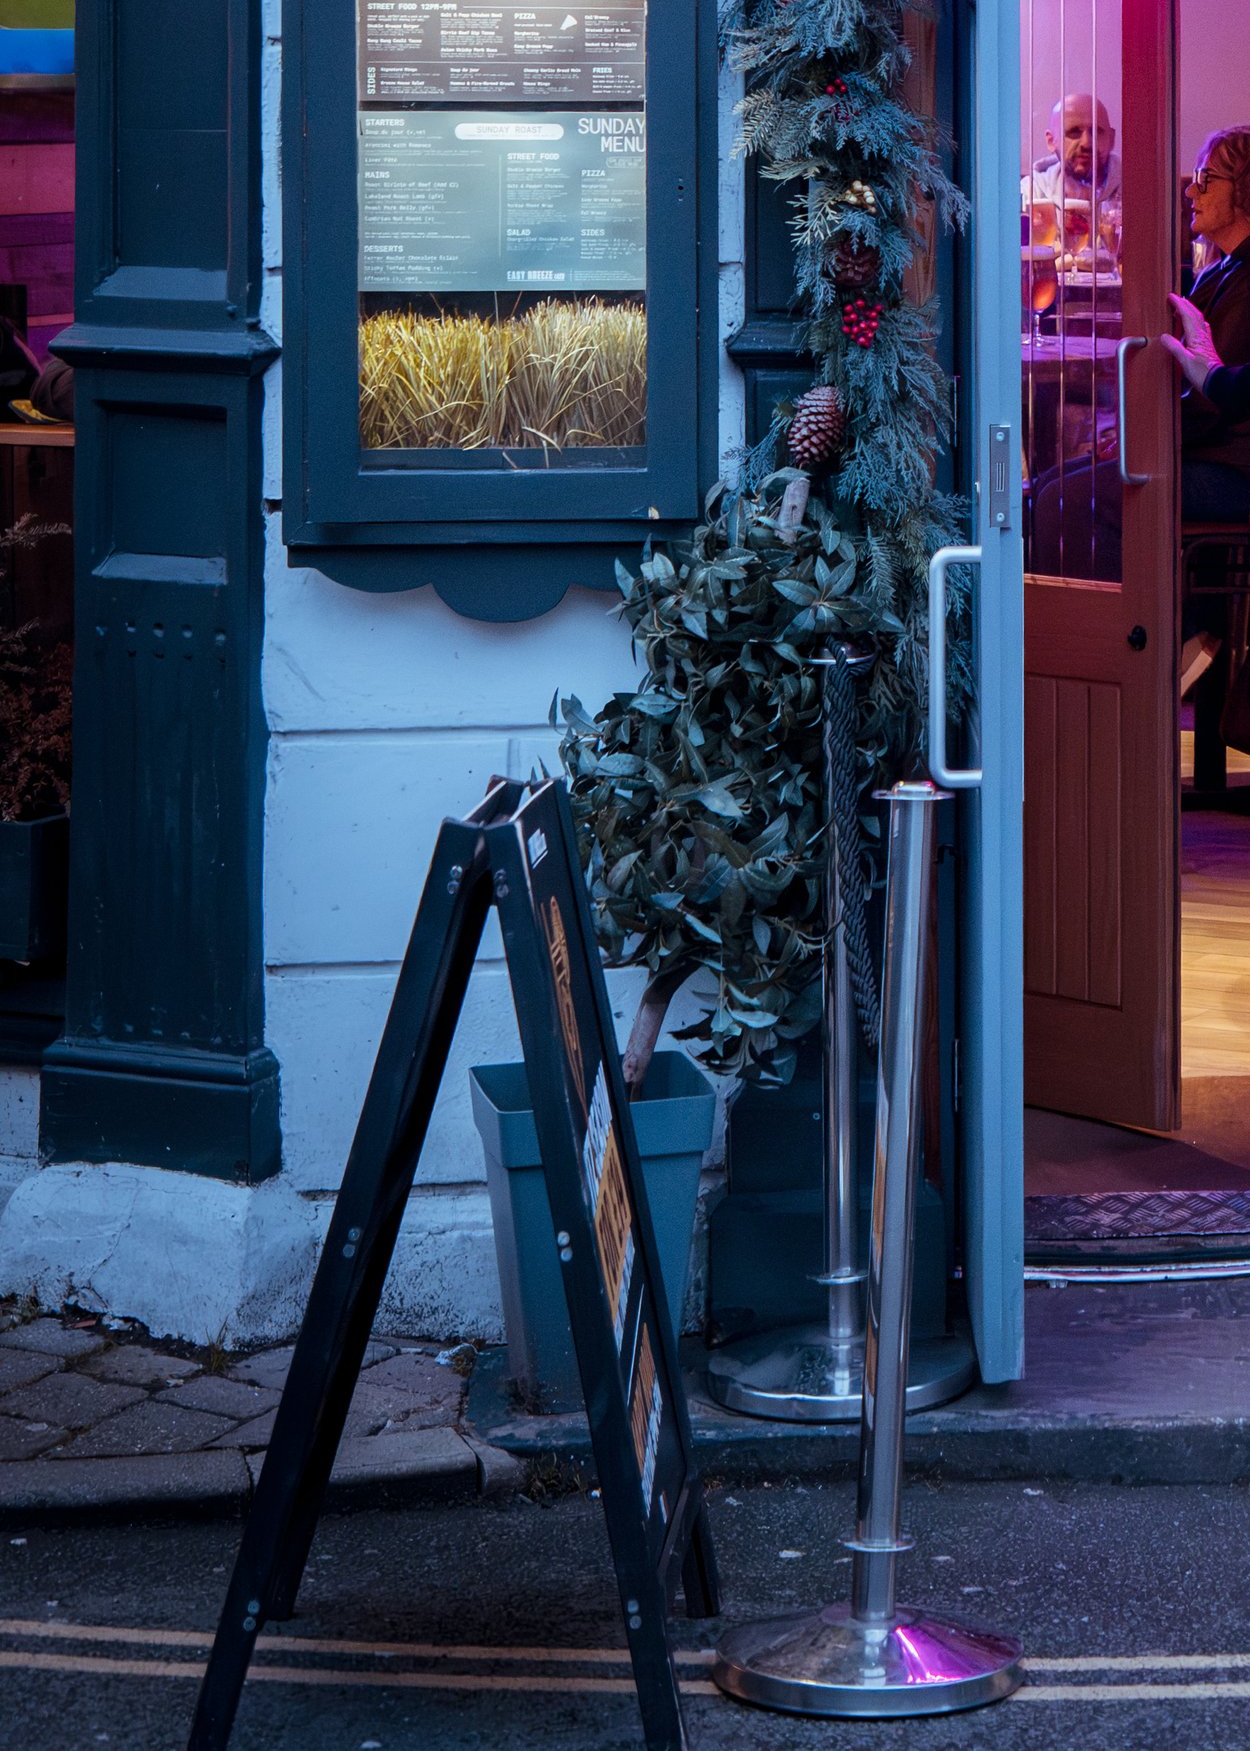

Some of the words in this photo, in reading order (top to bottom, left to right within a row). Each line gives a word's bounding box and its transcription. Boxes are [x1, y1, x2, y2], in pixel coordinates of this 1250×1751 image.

[367, 67, 376, 95] SIDES
[365, 119, 405, 127] STARTERS
[577, 117, 646, 134] SUNDAY
[515, 126, 542, 134] ROAST
[600, 136, 646, 153] MENU
[364, 171, 390, 179] MAINS
[364, 245, 404, 253] DESSERTS
[507, 270, 526, 280] EASY
[528, 270, 554, 280] BREEZE
[606, 1141, 627, 1250] £14
[597, 1183, 620, 1302] FOR
